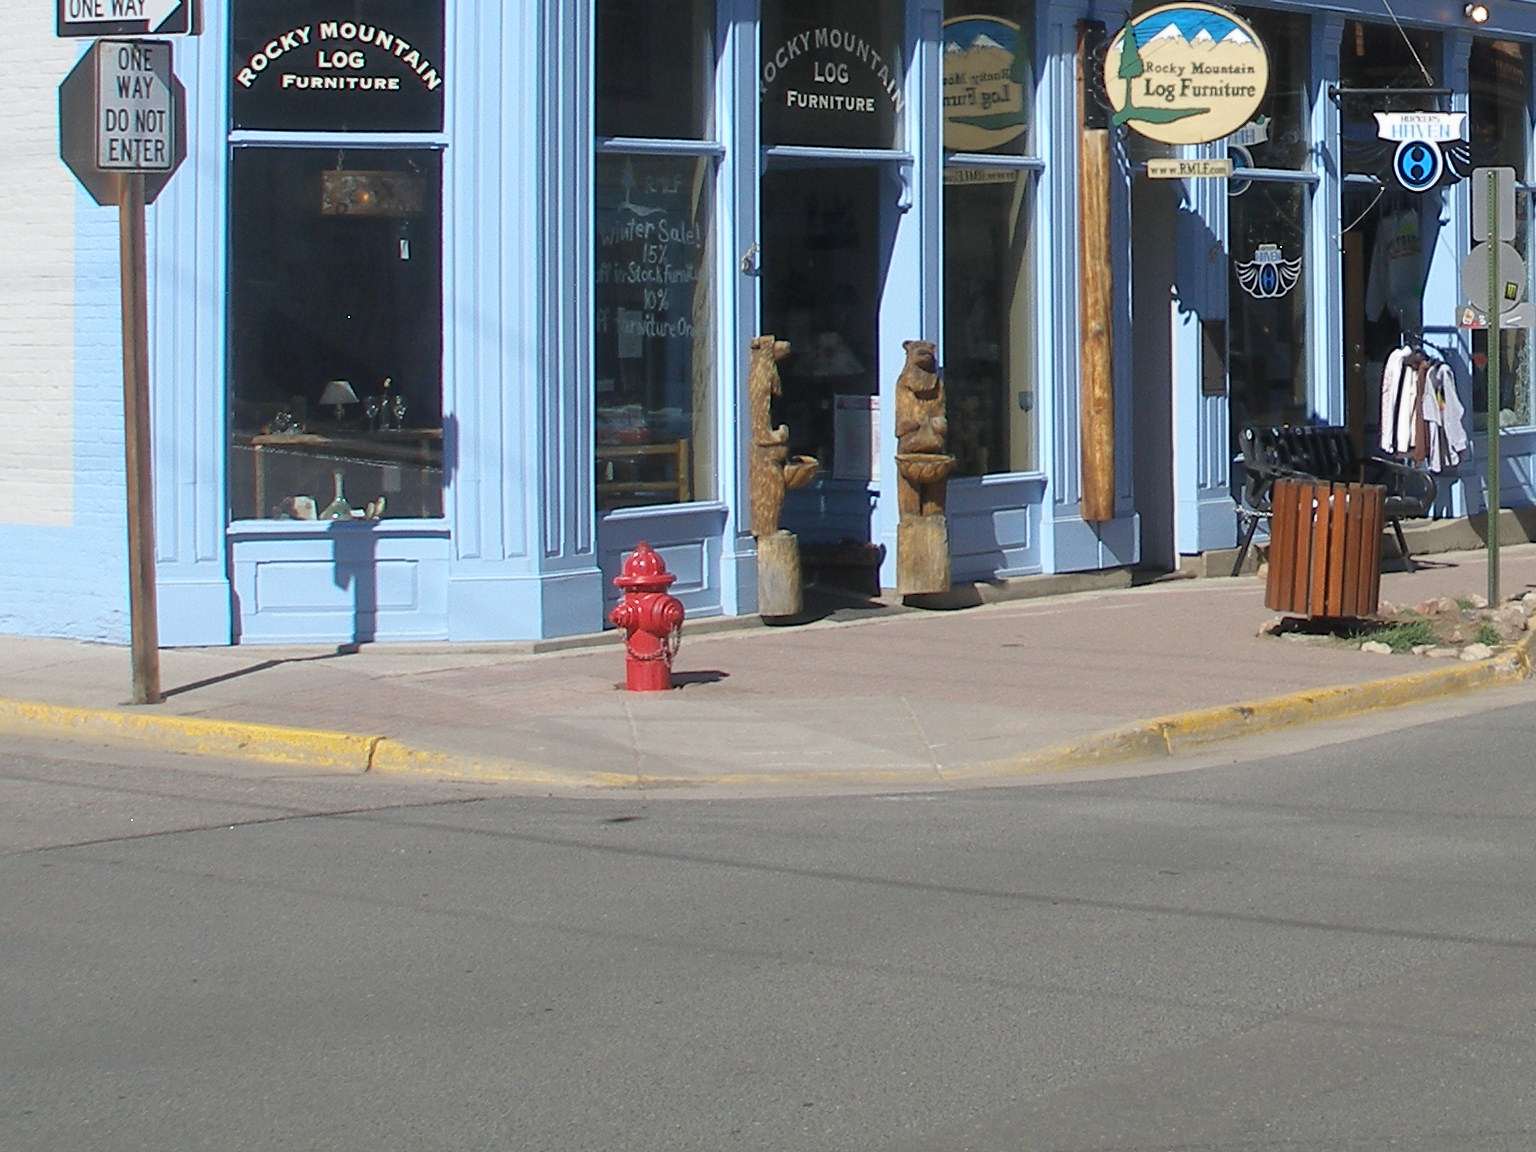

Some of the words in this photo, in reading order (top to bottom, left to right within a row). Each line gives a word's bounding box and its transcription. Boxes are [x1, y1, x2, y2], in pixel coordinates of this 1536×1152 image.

[118, 47, 153, 71] ONE
[236, 25, 311, 88] ROCKY
[318, 21, 442, 91] MOUNTAIN
[317, 51, 365, 69] LOG
[813, 61, 849, 84] LOG
[814, 27, 905, 114] MOUNTAIN
[1145, 61, 1186, 77] Rocky
[1190, 61, 1255, 75] Mountain
[116, 75, 154, 99] WAY
[281, 74, 400, 90] FURNITURE
[1144, 78, 1176, 102] Log
[1180, 78, 1256, 97] Furniture
[787, 90, 875, 111] FURNITURE
[105, 108, 129, 132] DO
[135, 109, 166, 133] NOT
[109, 138, 165, 162] ENTER
[657, 219, 701, 248] Sale!
[642, 245, 668, 265] 15%
[643, 288, 669, 311] 10%
